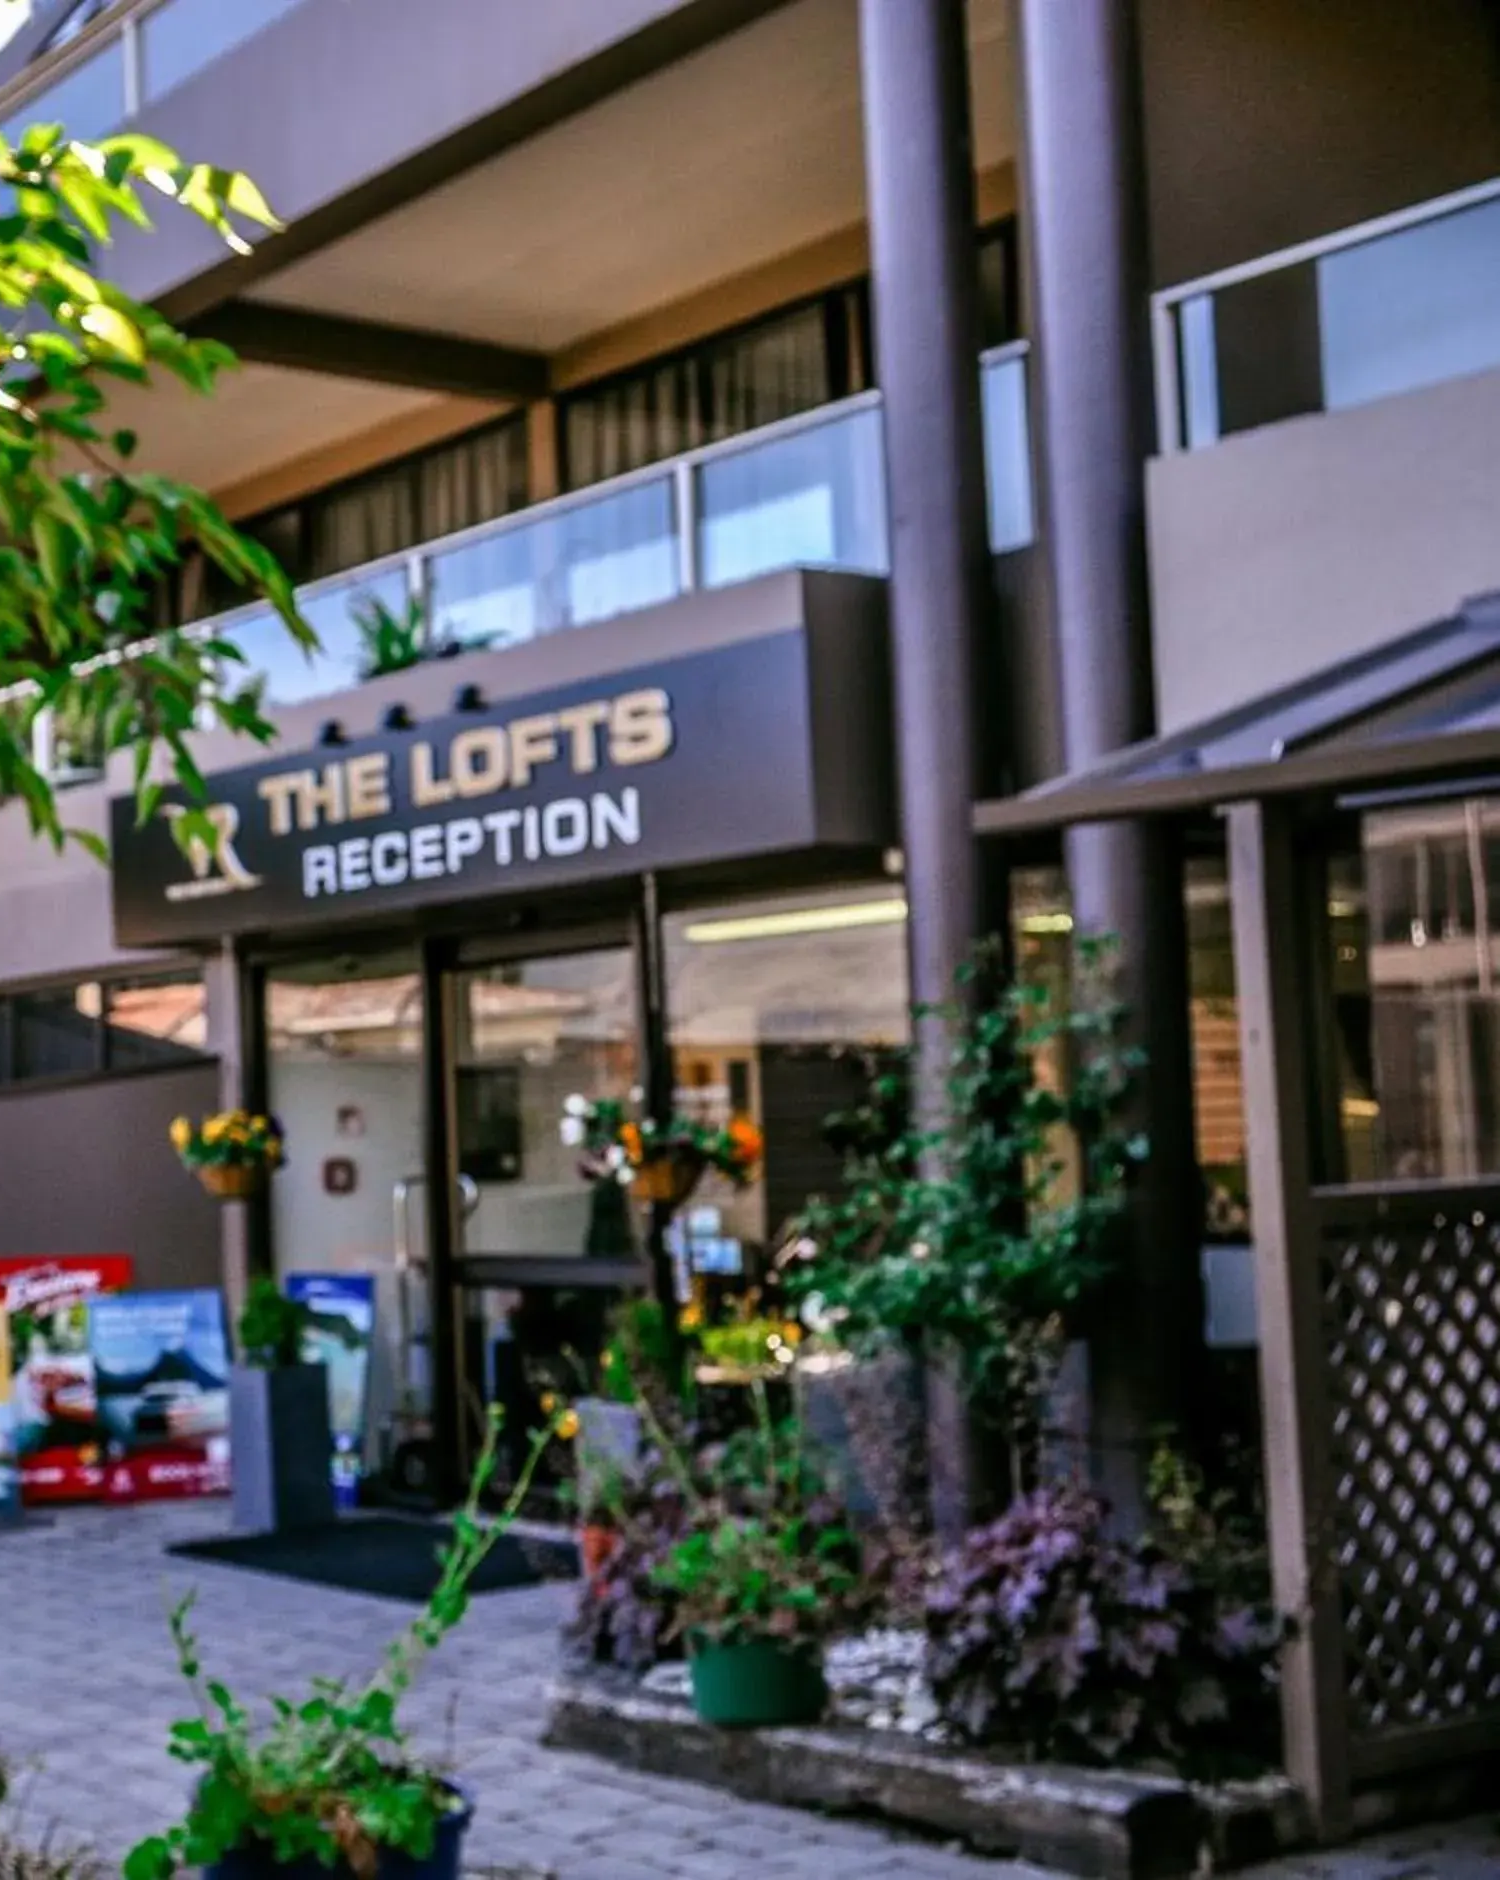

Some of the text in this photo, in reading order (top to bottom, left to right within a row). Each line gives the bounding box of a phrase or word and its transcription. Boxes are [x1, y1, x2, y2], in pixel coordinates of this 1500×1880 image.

[259, 688, 672, 835] THE LOFTS
[303, 788, 641, 897] RECEPTION
